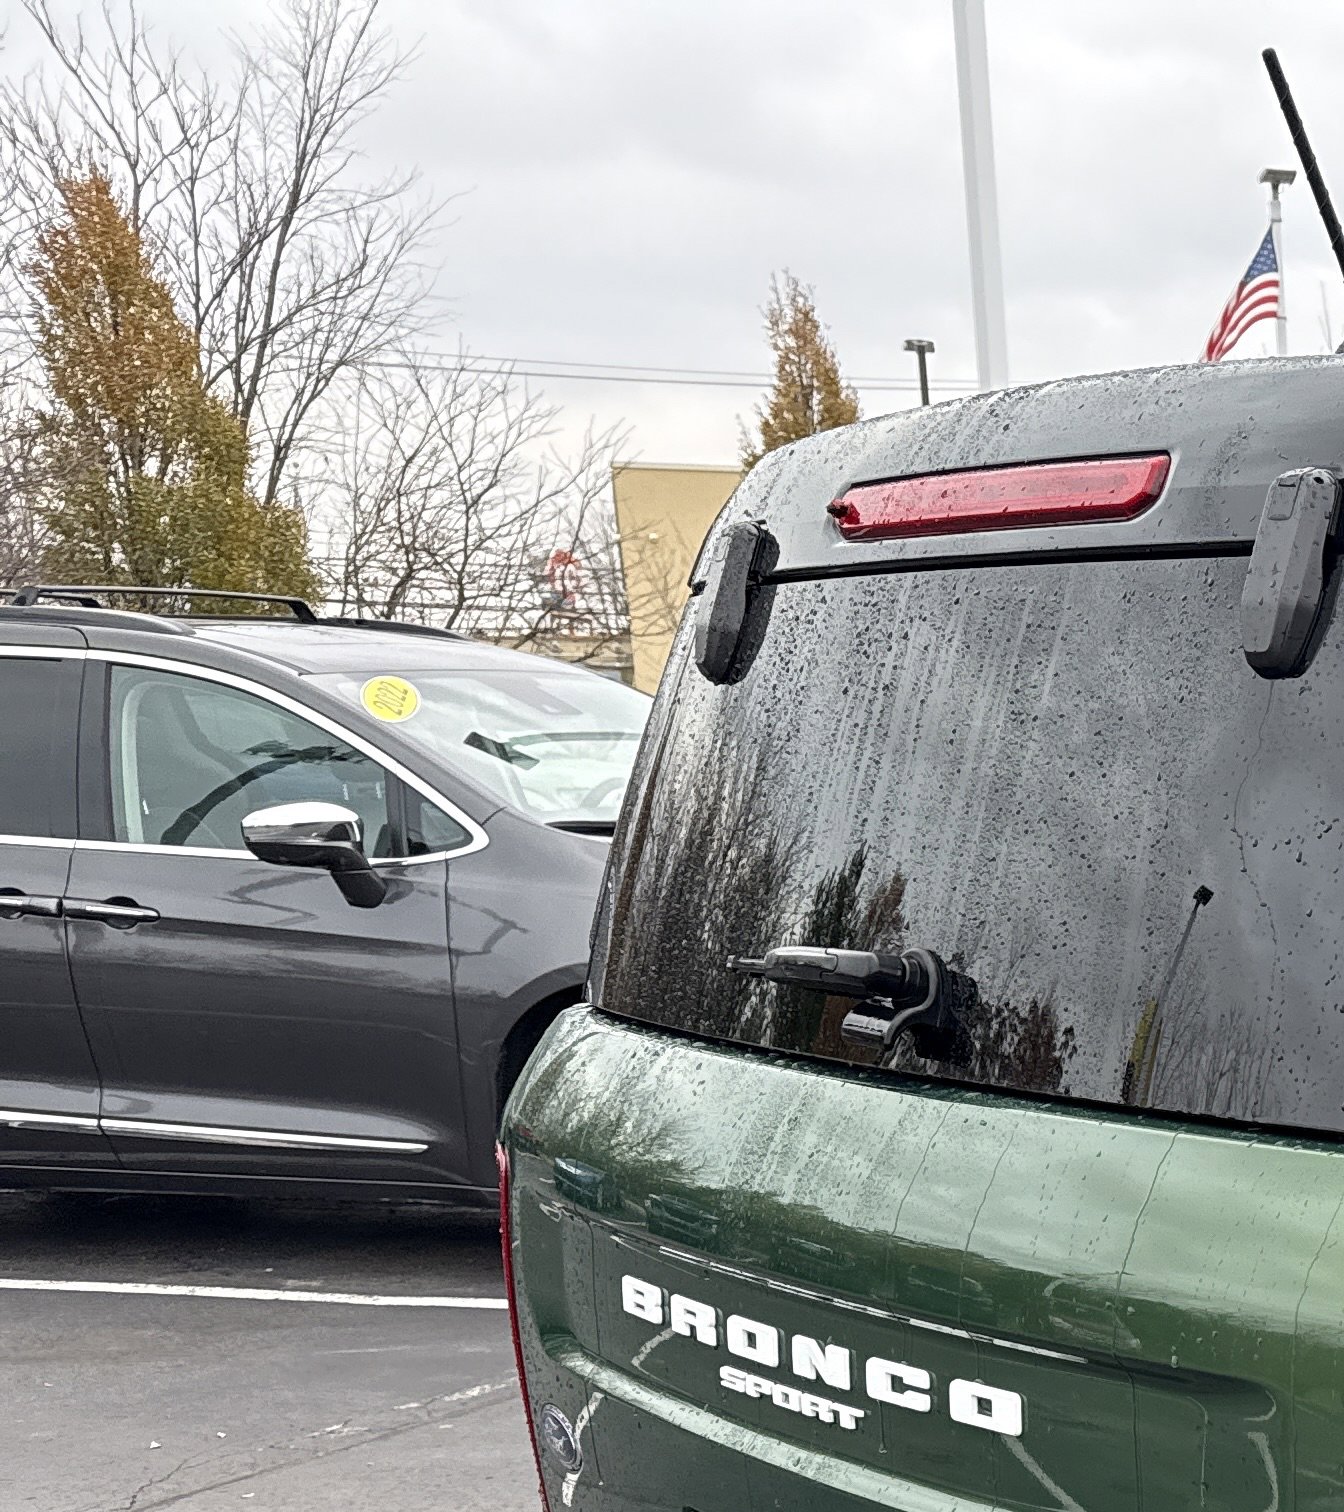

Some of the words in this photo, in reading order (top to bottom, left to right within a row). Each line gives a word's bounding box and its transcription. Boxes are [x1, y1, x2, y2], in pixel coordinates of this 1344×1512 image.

[373, 681, 408, 716] 2022
[621, 1274, 1023, 1437] BRONCO
[719, 1365, 865, 1430] SPORT
